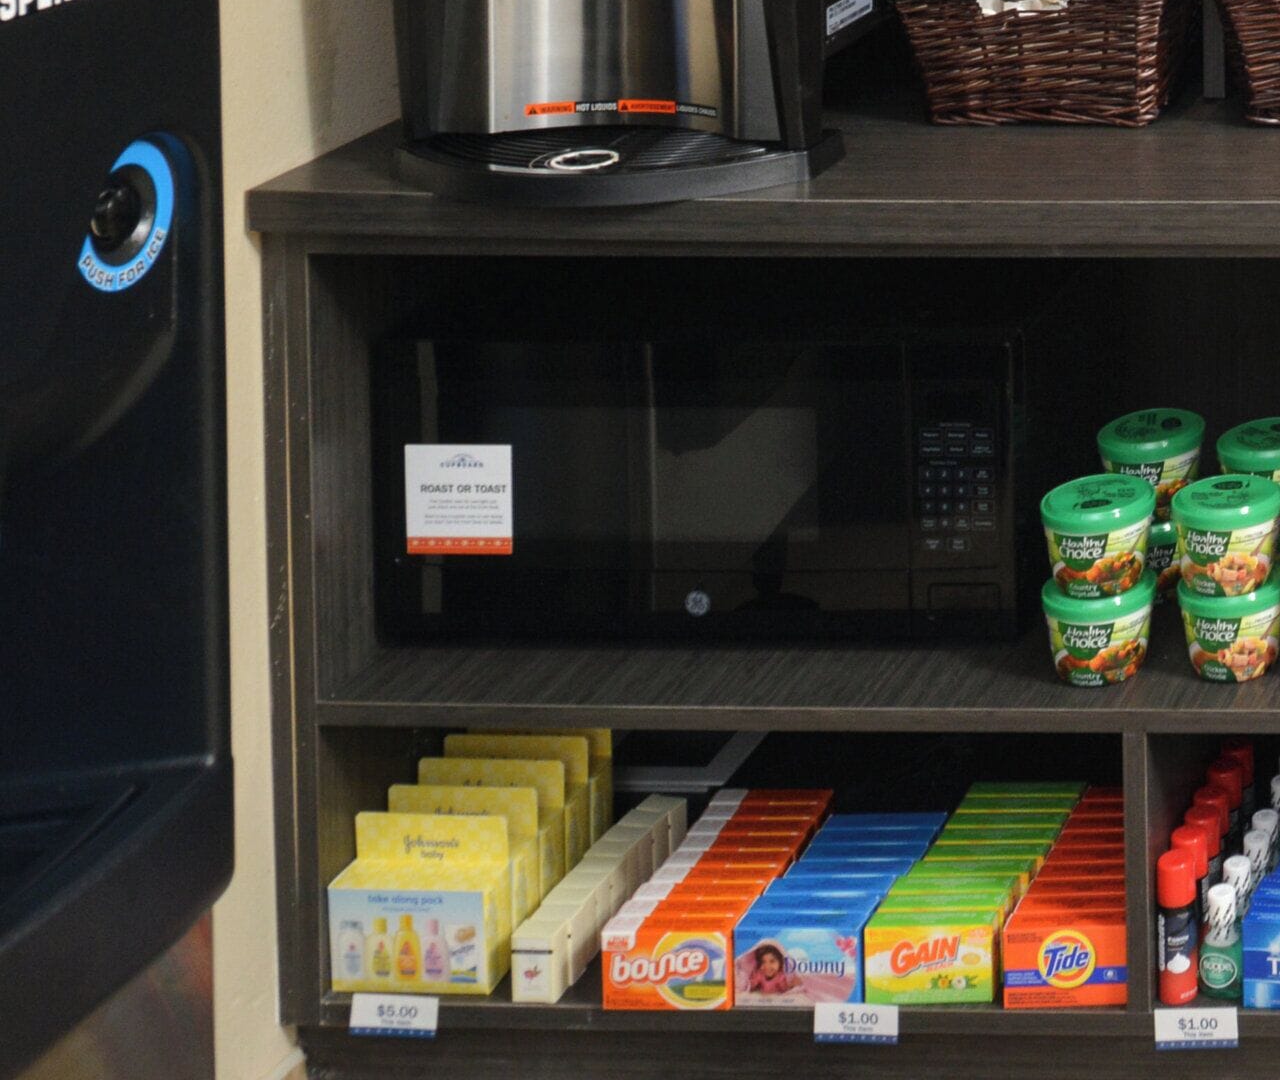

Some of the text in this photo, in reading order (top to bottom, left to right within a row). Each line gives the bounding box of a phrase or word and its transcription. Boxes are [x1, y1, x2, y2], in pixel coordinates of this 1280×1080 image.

[80, 228, 165, 289] PUSH FOR ICE
[420, 484, 507, 493] ROAST OR TOAST
[1063, 535, 1106, 551] Healthy
[1187, 531, 1229, 548] Healthy
[1058, 545, 1105, 560] Choice
[1185, 542, 1226, 557] Choice
[1066, 626, 1112, 641] Healthy
[1196, 618, 1238, 634] Healthy
[1062, 635, 1110, 649] Choice
[1192, 629, 1235, 643] Choice
[420, 850, 445, 861] baby
[367, 894, 444, 907] take along pack
[890, 935, 961, 977] GAIN
[1043, 945, 1092, 977] Tide
[611, 949, 709, 985] bounce
[784, 955, 846, 977] Downy
[376, 1004, 418, 1019] $5.00
[838, 1011, 879, 1025] $1.00
[1178, 1018, 1218, 1030] $1.00
